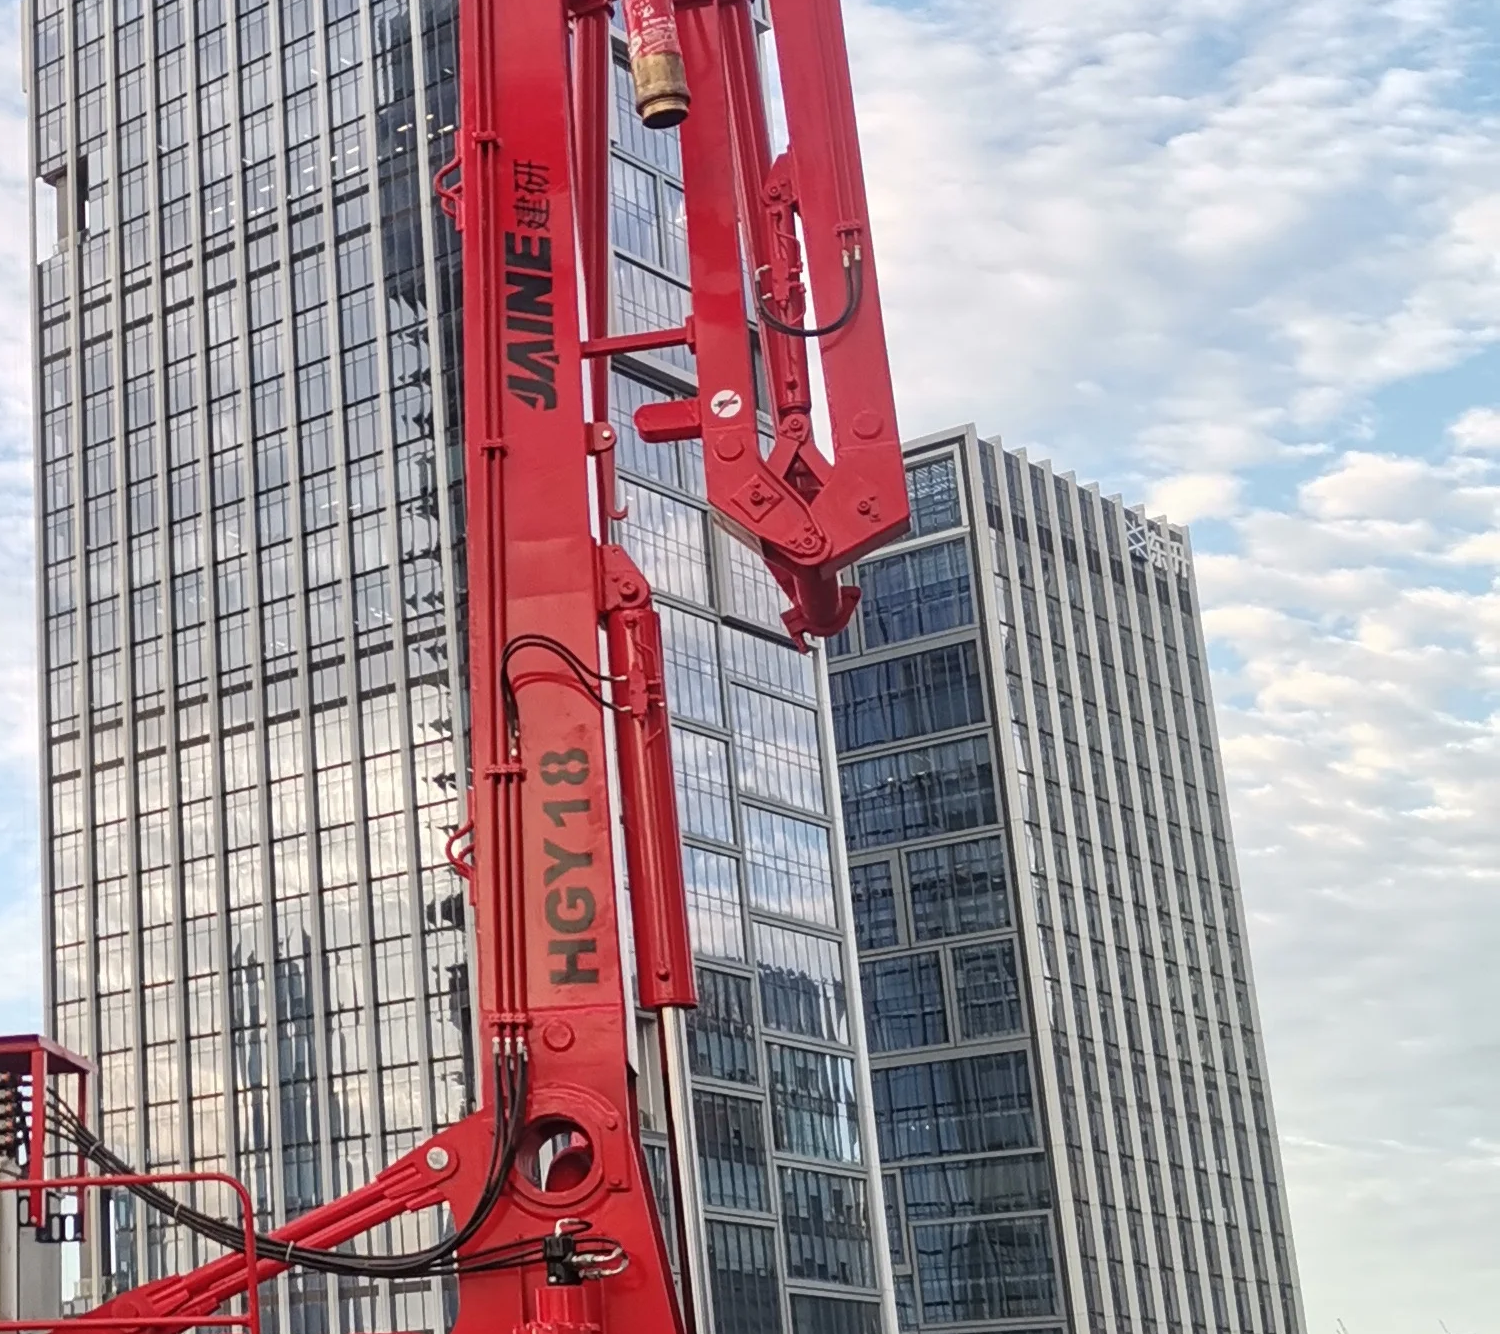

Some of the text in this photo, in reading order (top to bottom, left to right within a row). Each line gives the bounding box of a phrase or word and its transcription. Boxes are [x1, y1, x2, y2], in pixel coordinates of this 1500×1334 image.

[504, 158, 560, 412] JAINE 建研
[539, 746, 600, 986] HGY18
